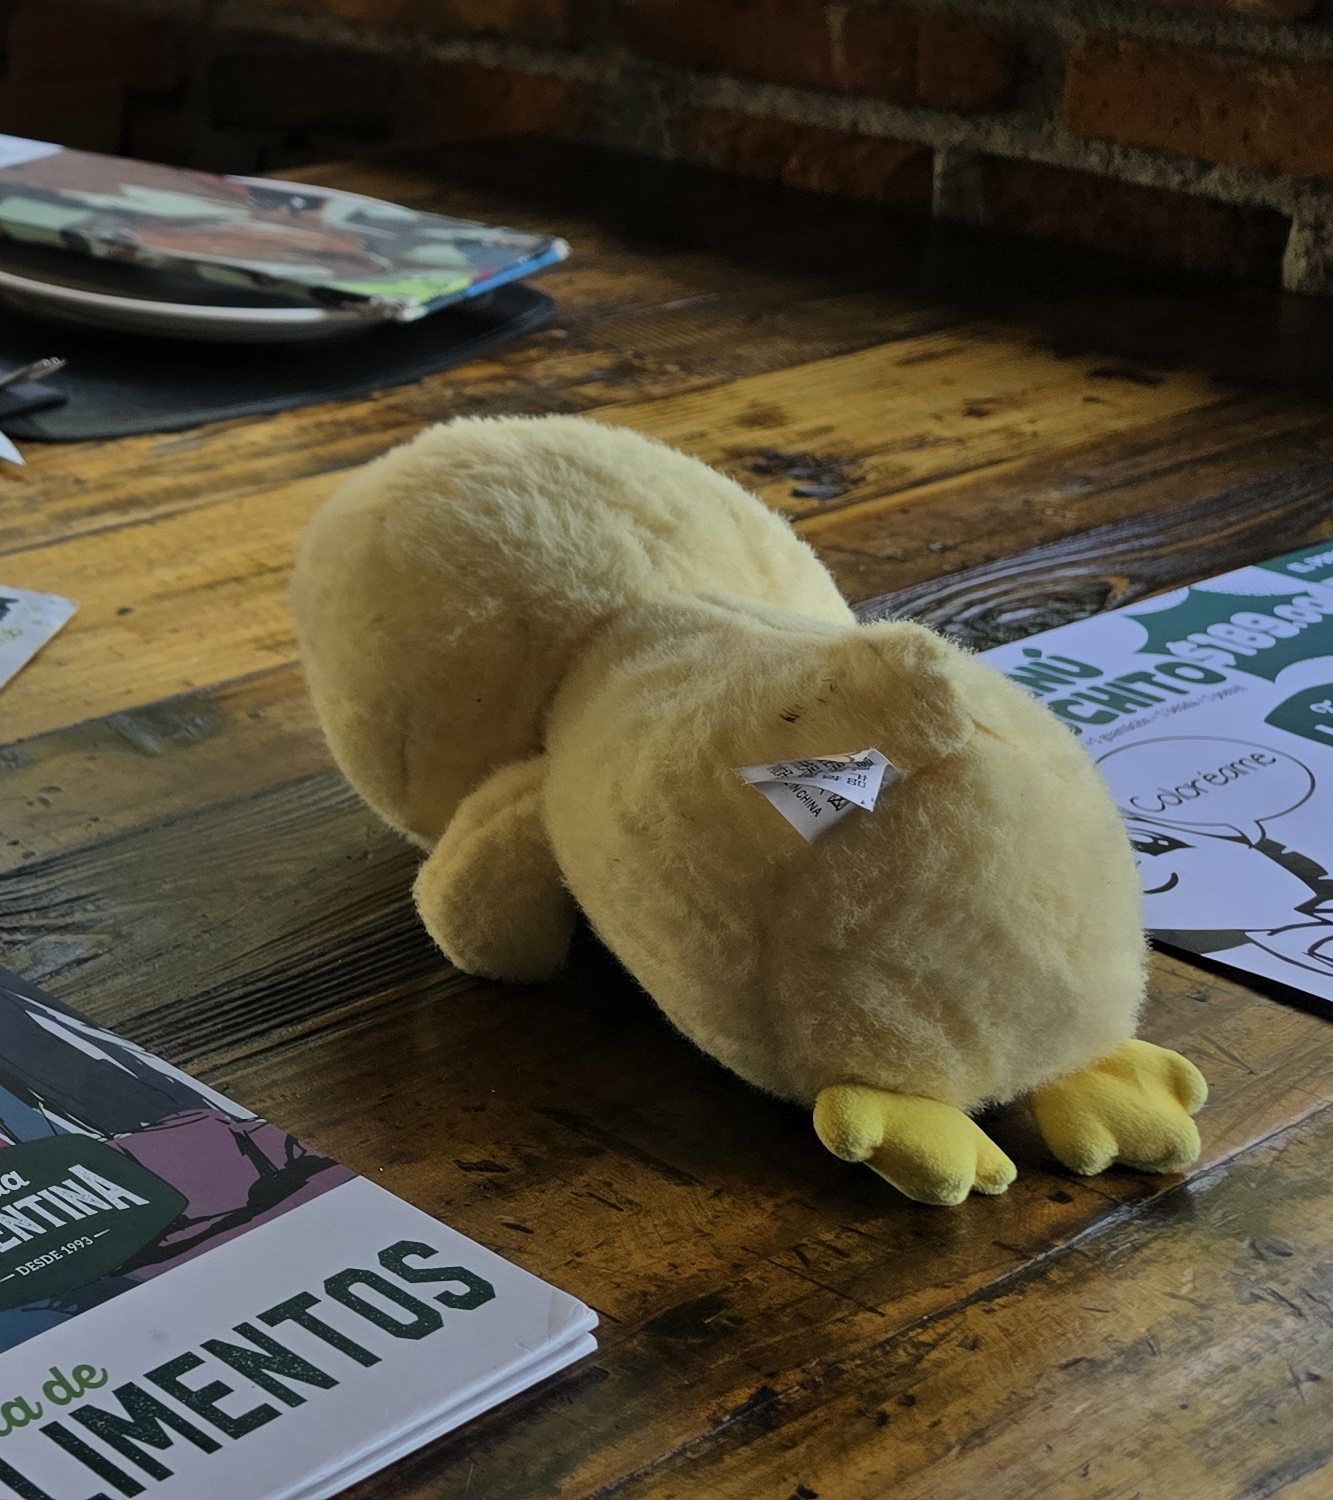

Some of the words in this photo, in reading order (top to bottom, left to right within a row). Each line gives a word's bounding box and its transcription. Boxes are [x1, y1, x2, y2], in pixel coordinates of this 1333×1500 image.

[1047, 661, 1228, 726] CHITO
[796, 788, 823, 818] CHINA
[1129, 753, 1277, 814] Coloréame
[15, 1248, 64, 1278] DESDE
[60, 1235, 94, 1257] 1993
[42, 1364, 109, 1406] de
